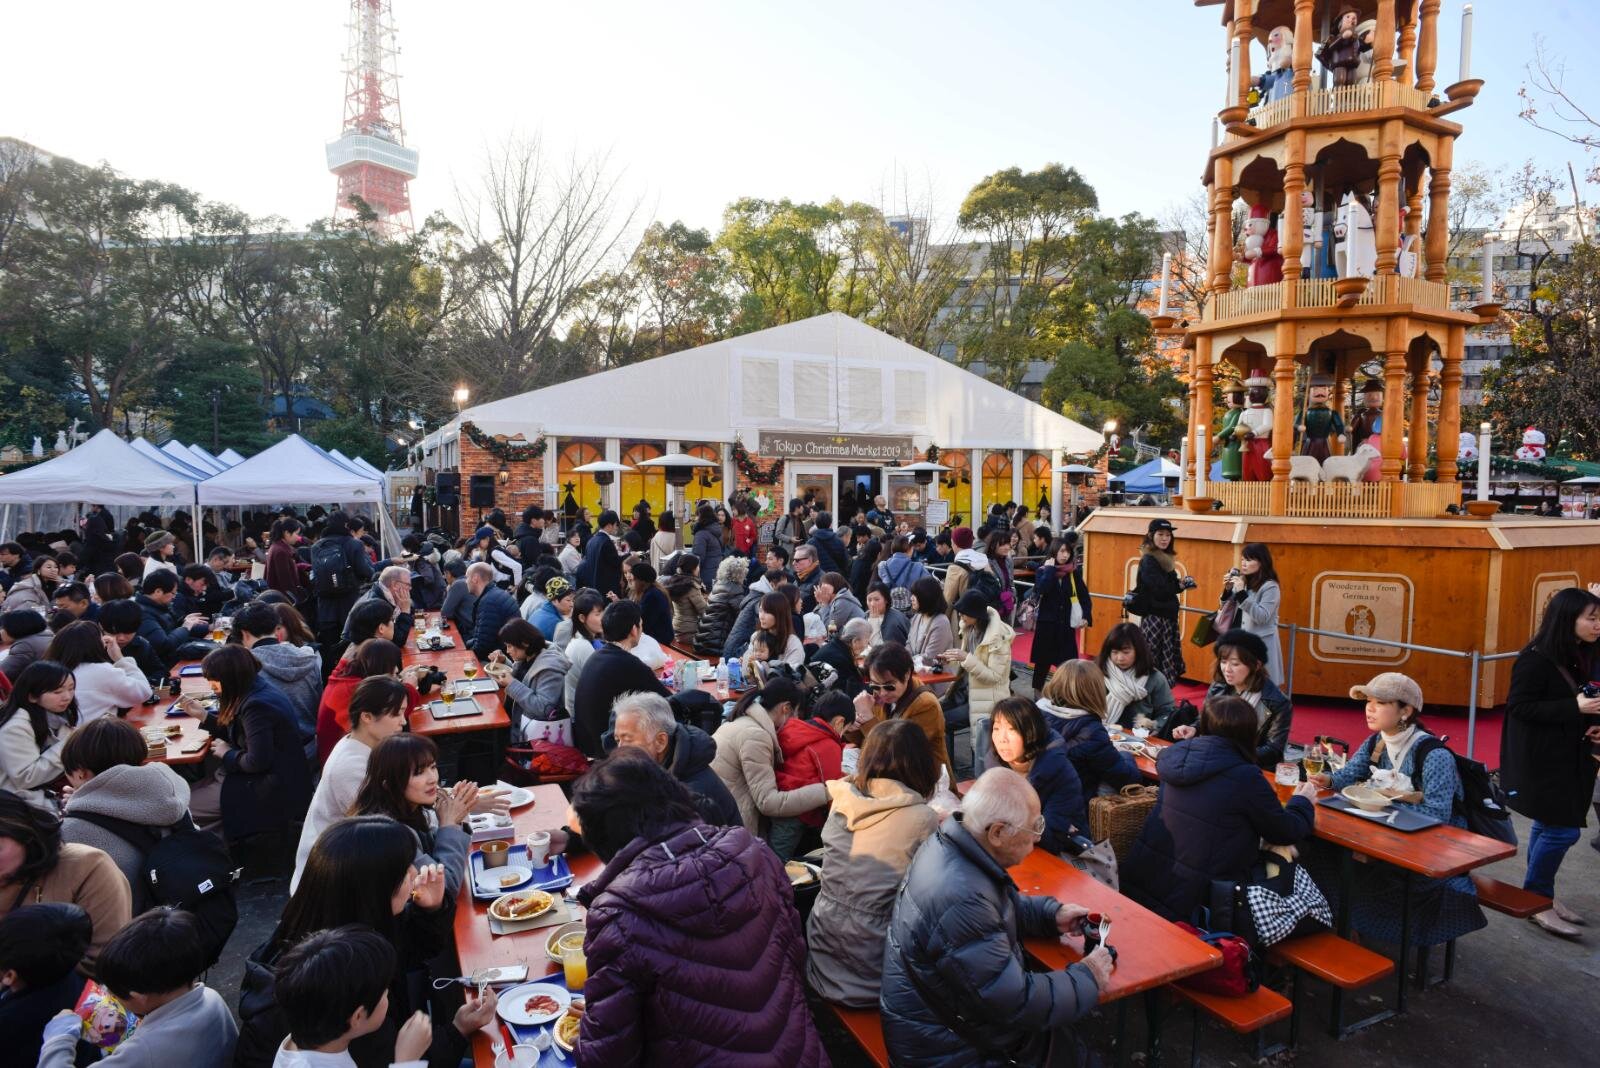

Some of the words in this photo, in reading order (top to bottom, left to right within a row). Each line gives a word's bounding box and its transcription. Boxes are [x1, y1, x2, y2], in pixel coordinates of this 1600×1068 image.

[773, 439, 801, 455] Tokyo
[805, 441, 849, 456] Christmas
[850, 443, 881, 457] Market
[881, 445, 901, 457] 2019
[1328, 582, 1369, 591] Woodcraft
[1377, 584, 1397, 592] from
[1342, 592, 1380, 601] Germany
